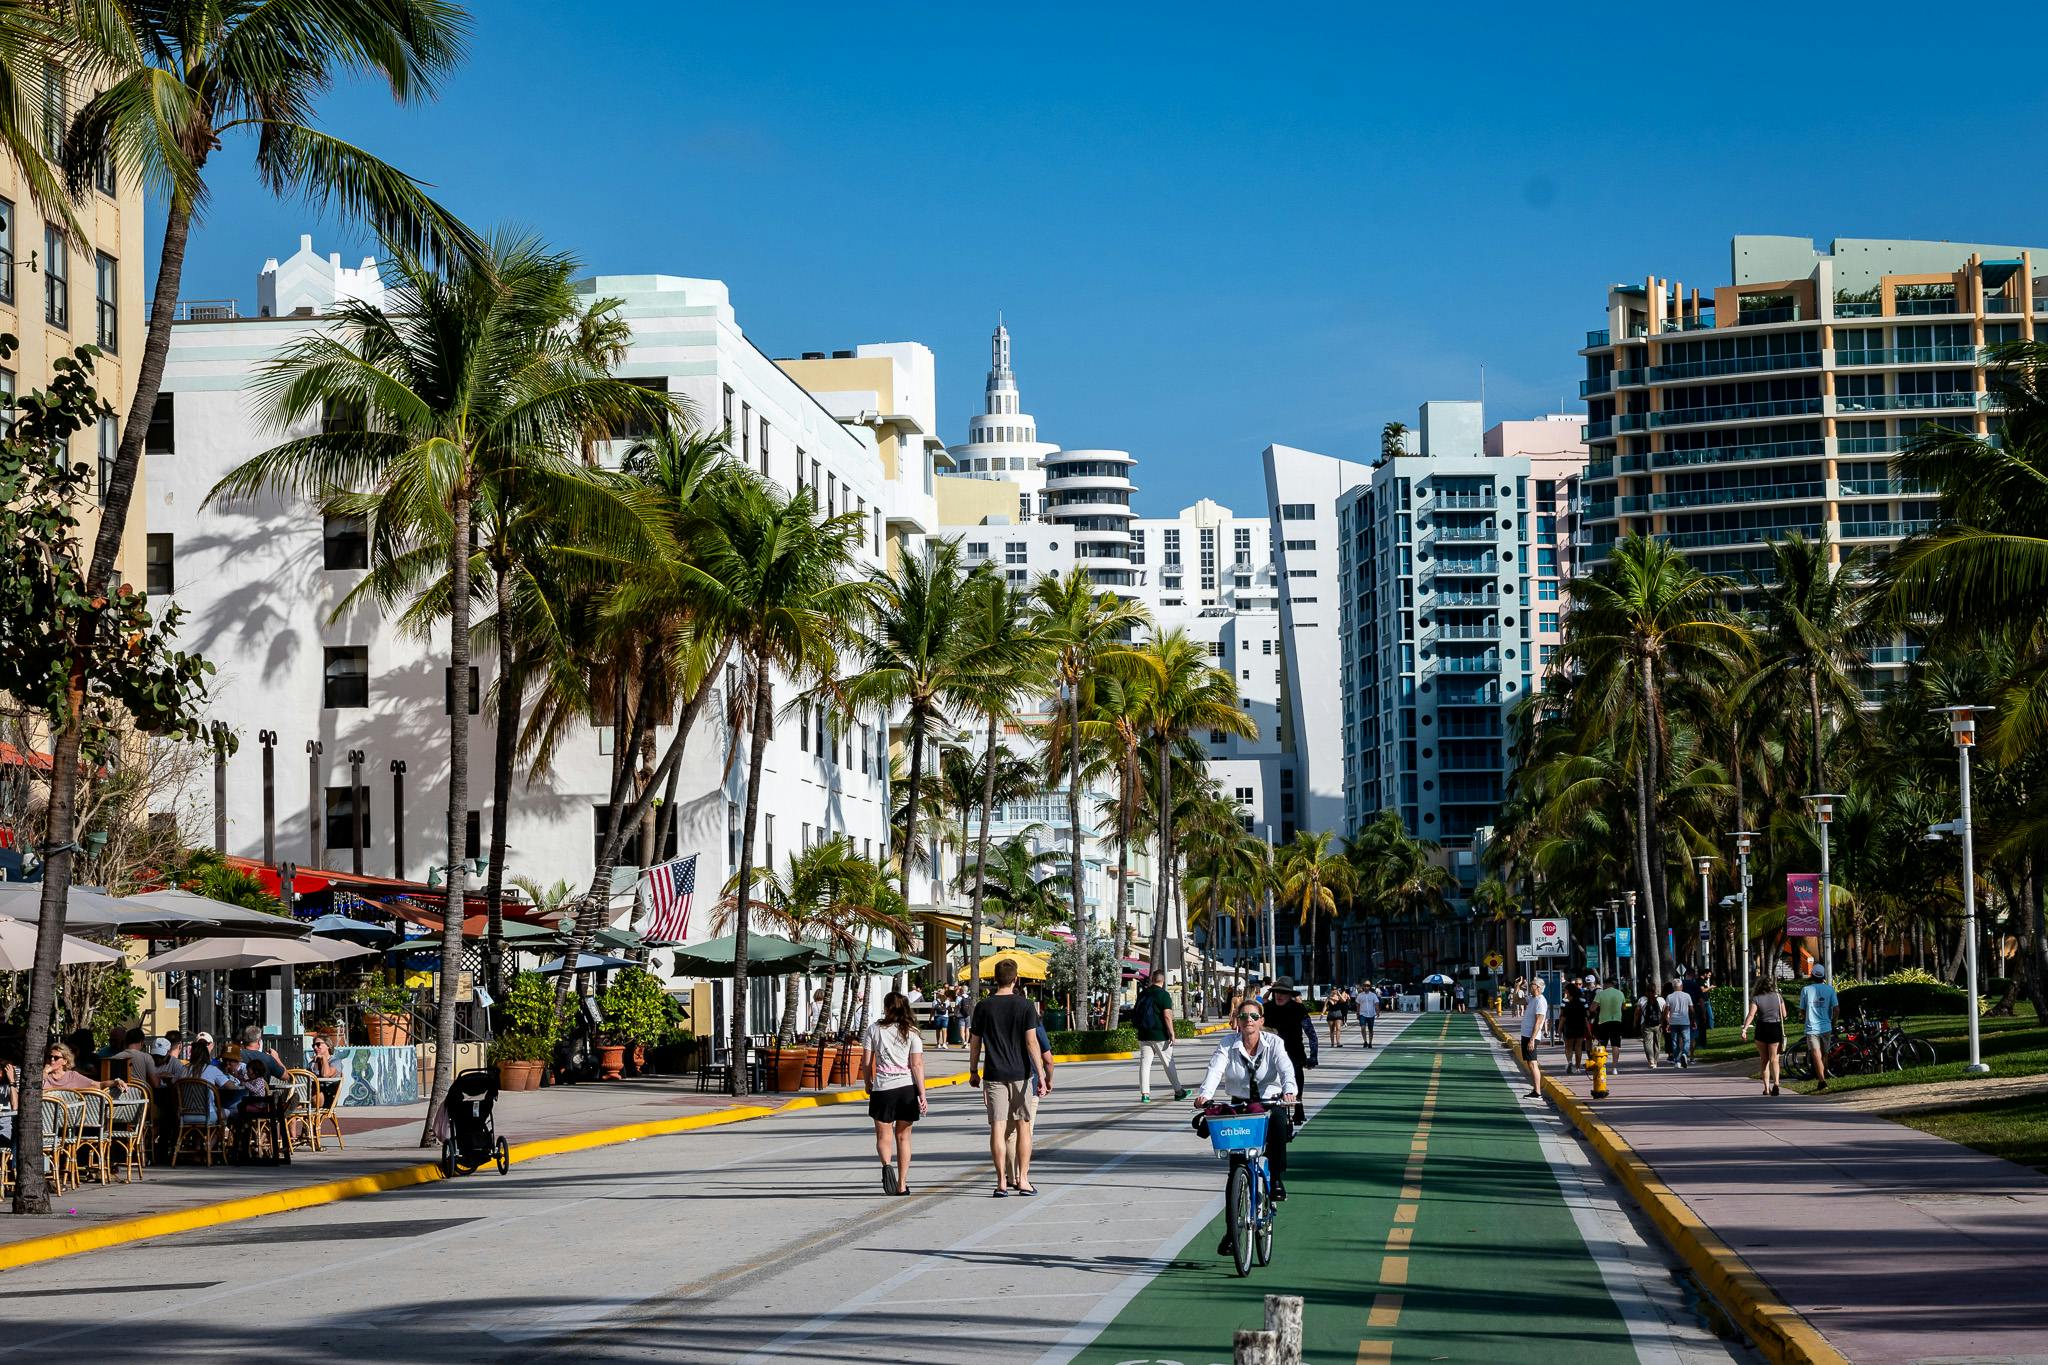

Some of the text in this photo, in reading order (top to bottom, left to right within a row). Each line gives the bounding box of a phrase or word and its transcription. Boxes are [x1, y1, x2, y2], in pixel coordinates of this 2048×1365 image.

[1793, 885, 1813, 893] YOUR
[1220, 1127, 1251, 1136] citi bike
